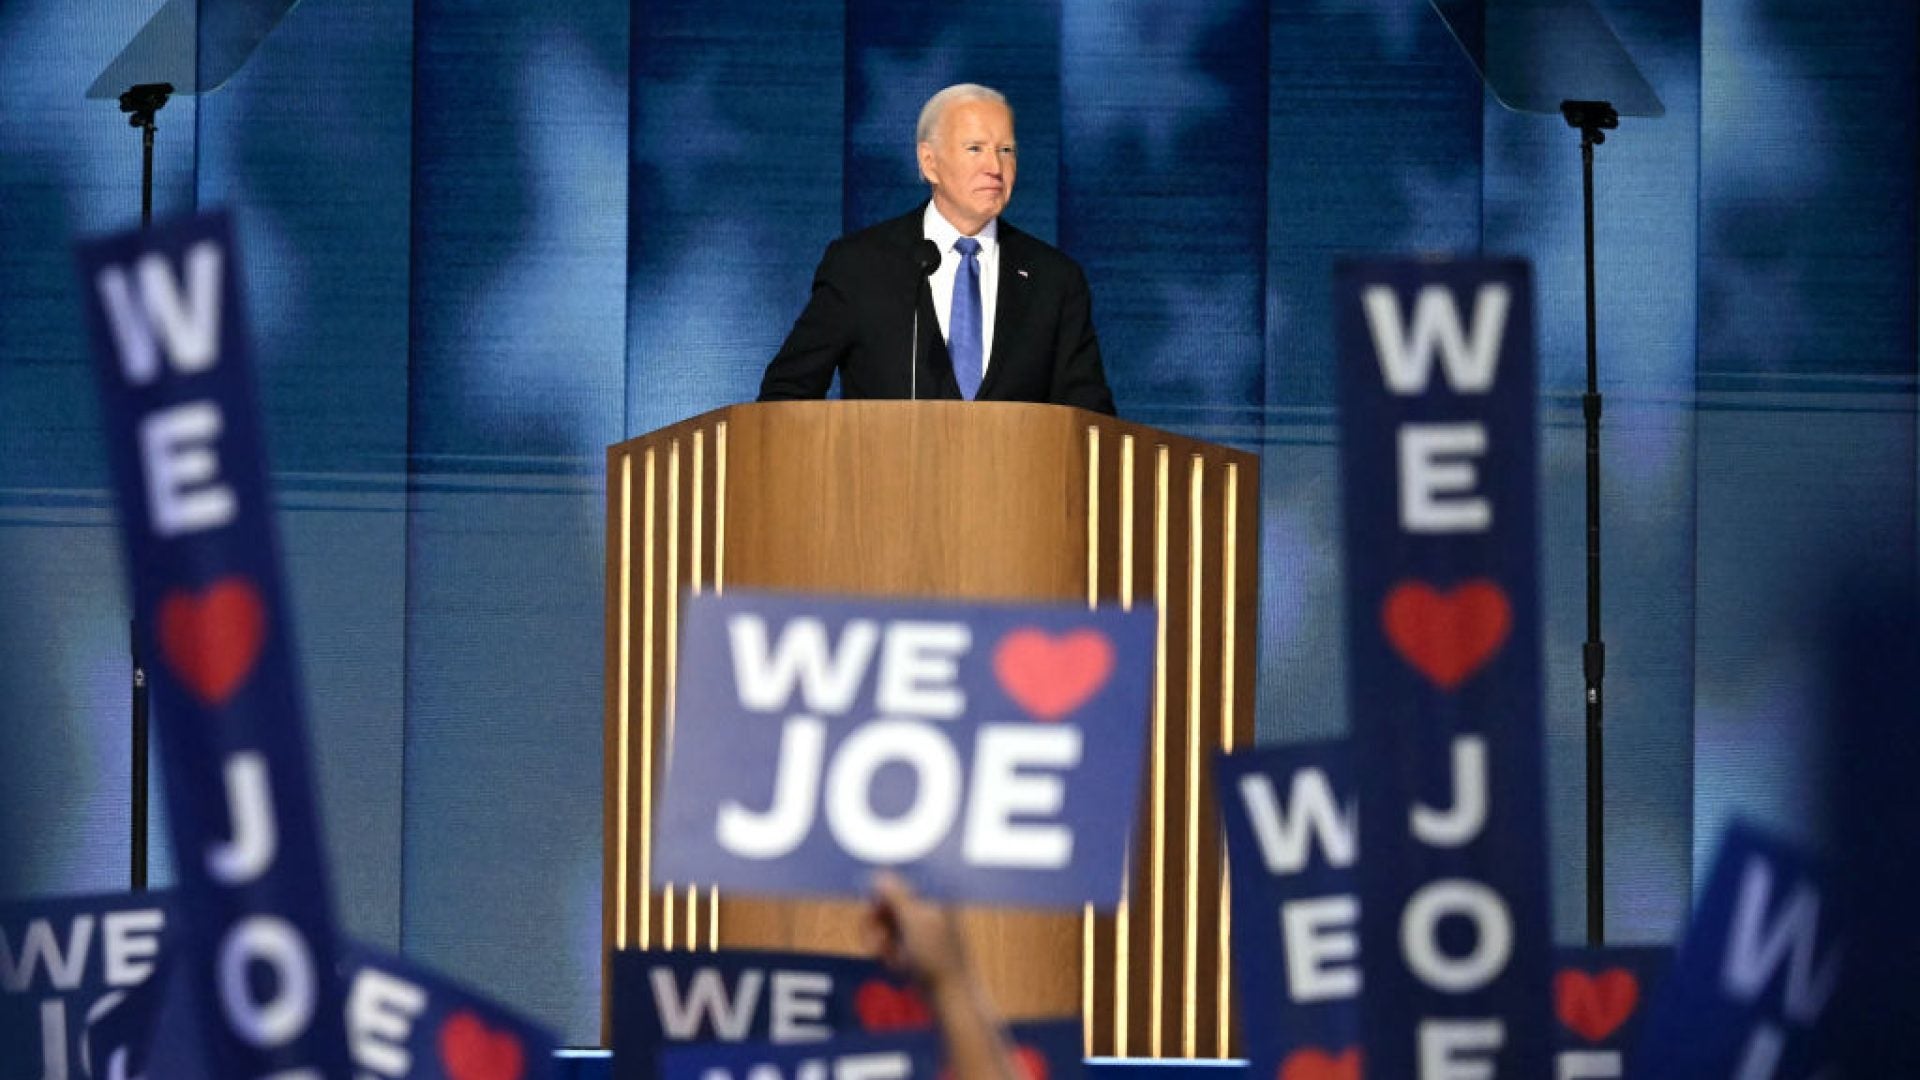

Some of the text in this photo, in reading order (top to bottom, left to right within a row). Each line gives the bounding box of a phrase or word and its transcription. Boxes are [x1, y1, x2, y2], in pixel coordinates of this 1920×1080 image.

[1361, 282, 1511, 534] WE
[97, 241, 326, 1080] WE JO
[727, 613, 973, 719] WE
[715, 714, 1084, 869] JOE
[0, 909, 165, 991] WE
[1238, 767, 1362, 1003] WE
[648, 966, 833, 1043] WE
